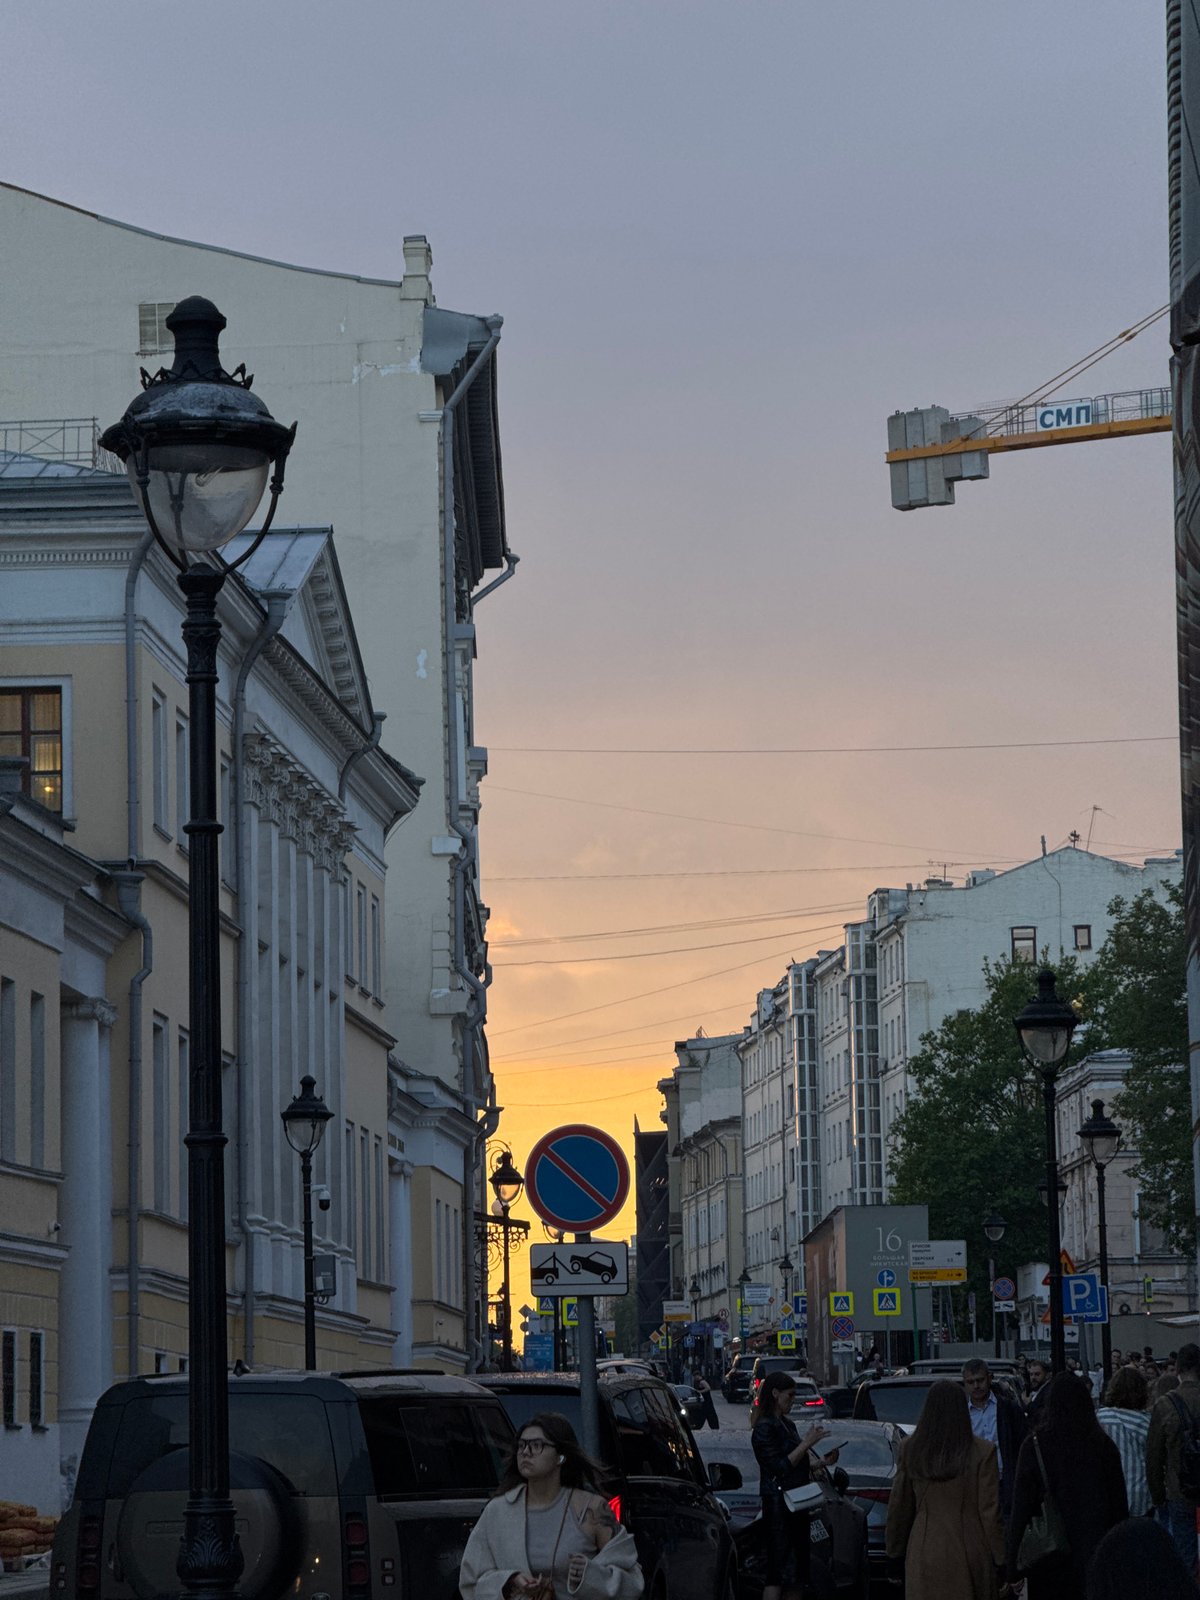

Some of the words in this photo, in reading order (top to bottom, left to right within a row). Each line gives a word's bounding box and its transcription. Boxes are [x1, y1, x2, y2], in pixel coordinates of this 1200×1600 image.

[1039, 405, 1091, 429] СМП
[875, 1226, 902, 1252] 16
[1069, 1278, 1091, 1311] P
